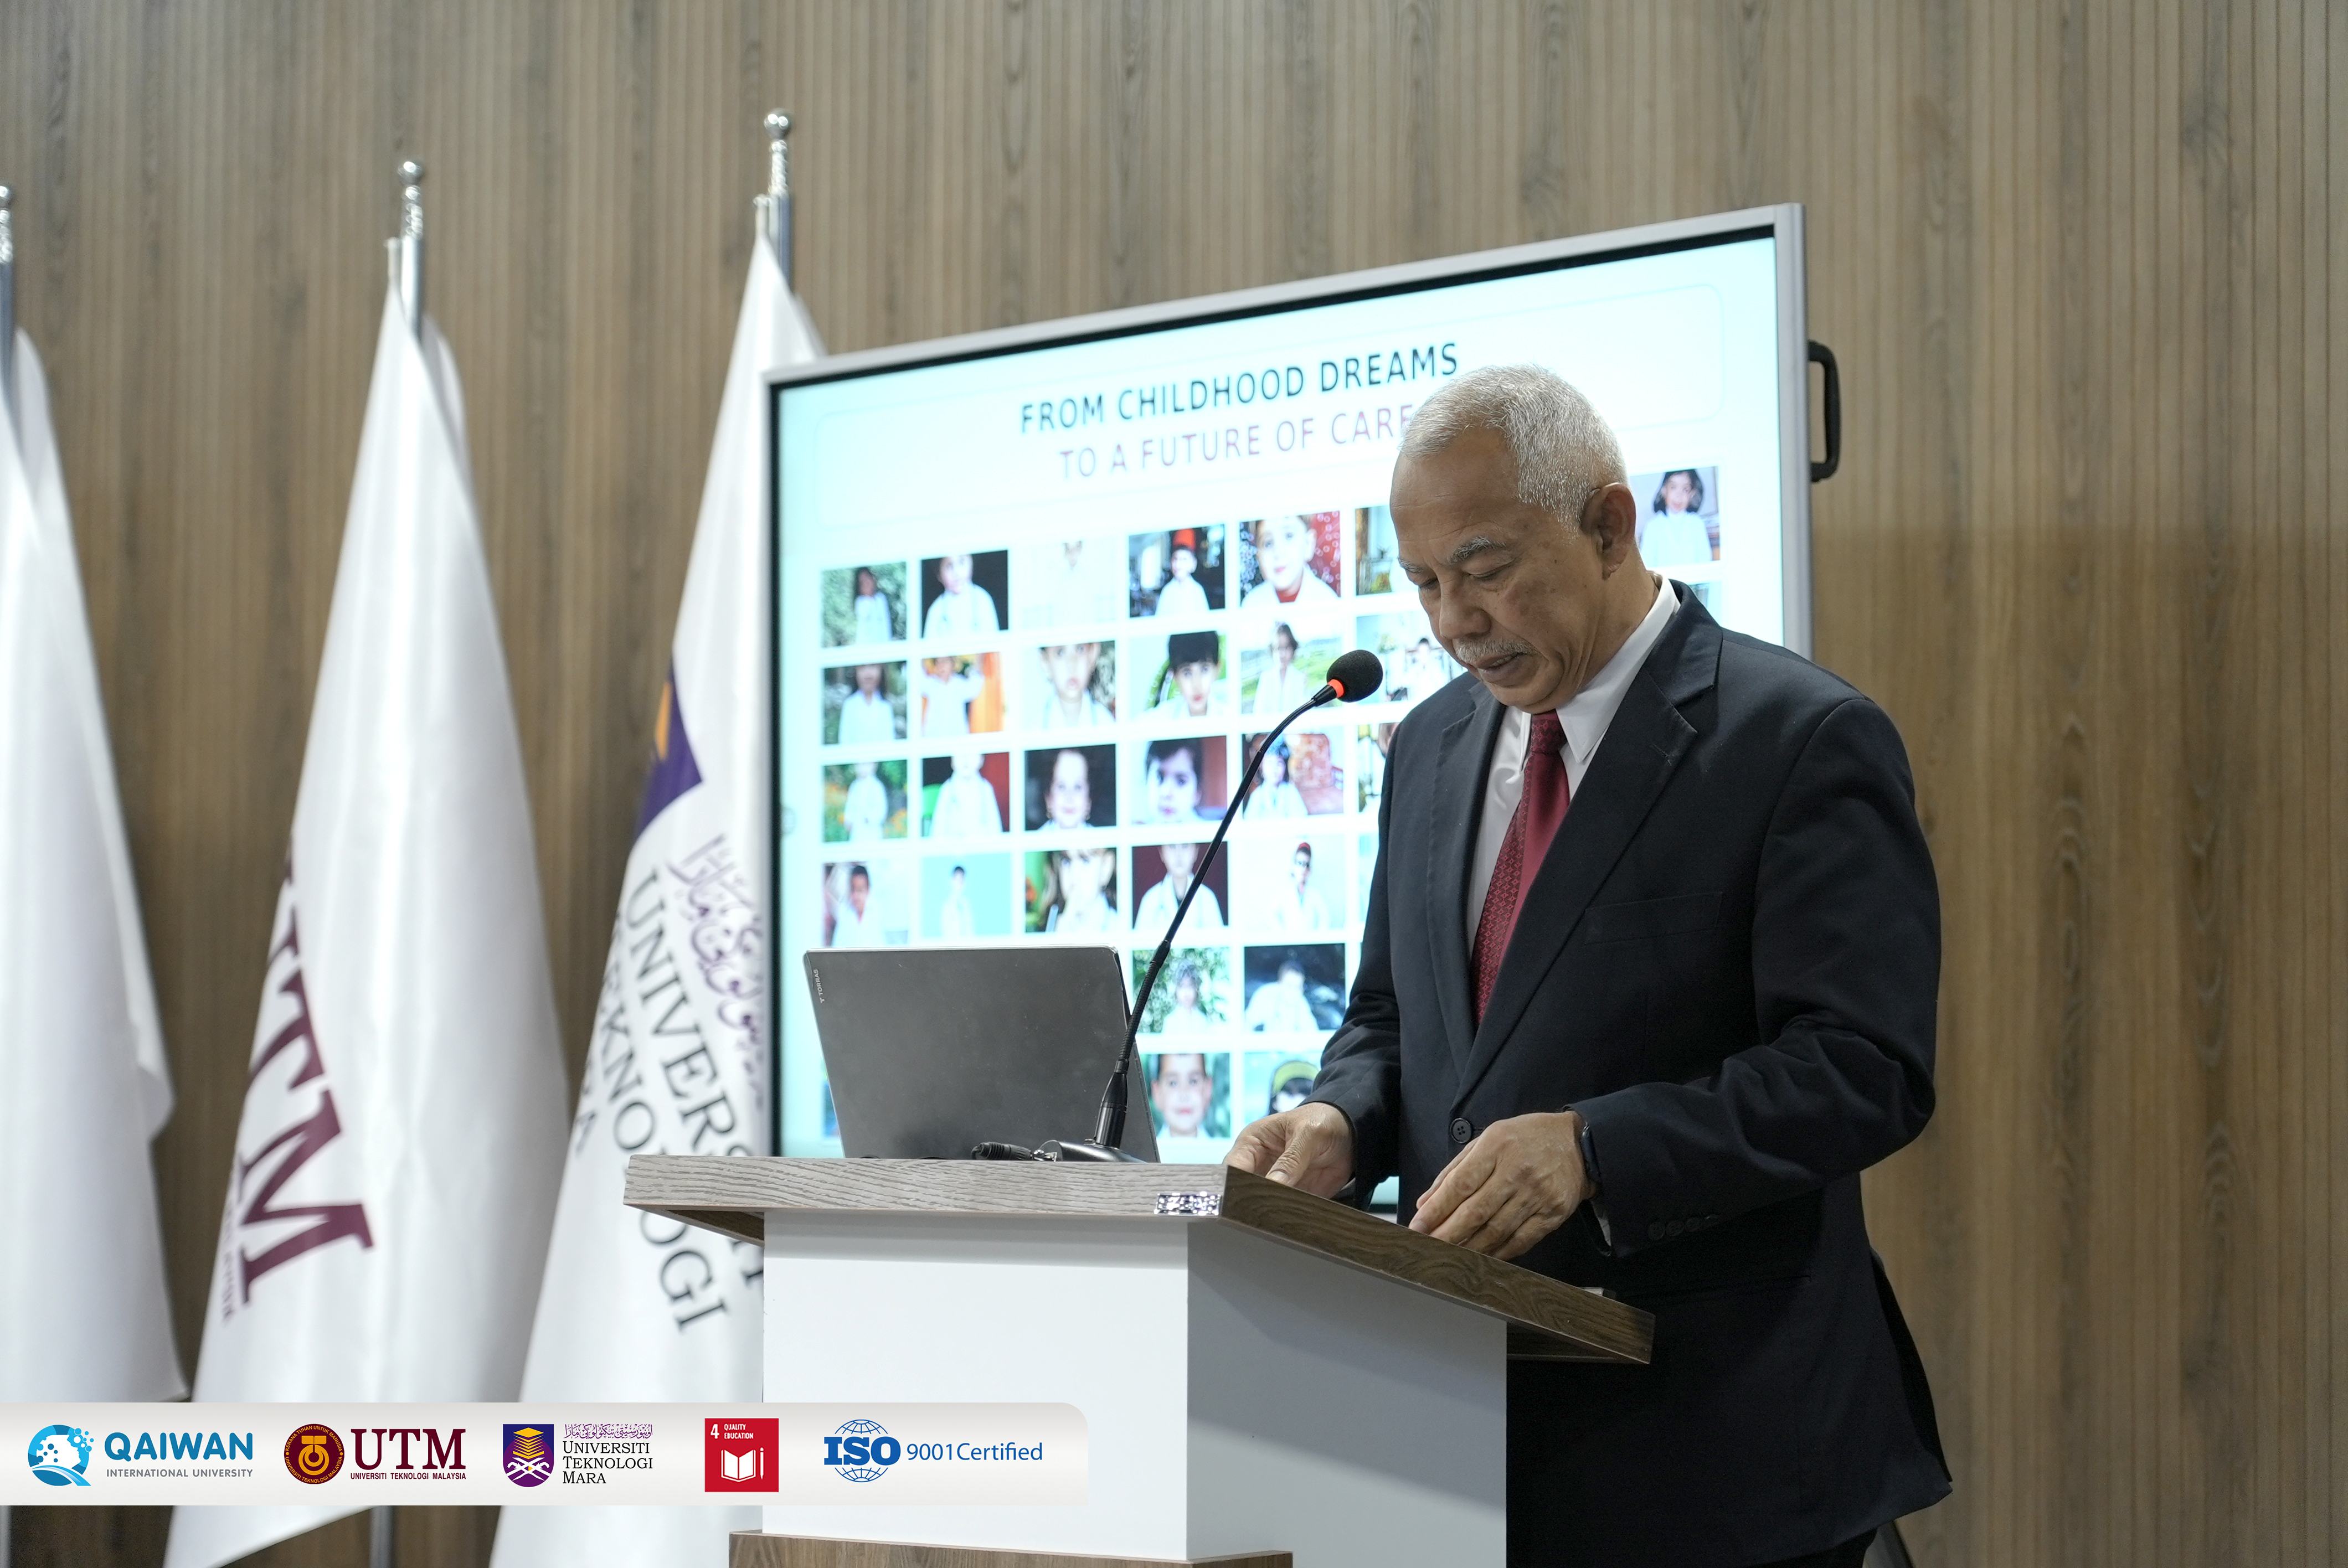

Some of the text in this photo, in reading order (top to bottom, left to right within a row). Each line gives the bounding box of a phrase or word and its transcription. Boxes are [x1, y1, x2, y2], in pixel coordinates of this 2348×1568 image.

[1022, 343, 1457, 433] FROM CHILDHOOD DREAMS
[1060, 447, 1095, 478] TO
[1112, 443, 1126, 471] A
[1142, 425, 1260, 468] FUTURE
[1276, 418, 1314, 452] OF
[813, 969, 823, 996] TORRAS
[238, 854, 375, 1305] TM
